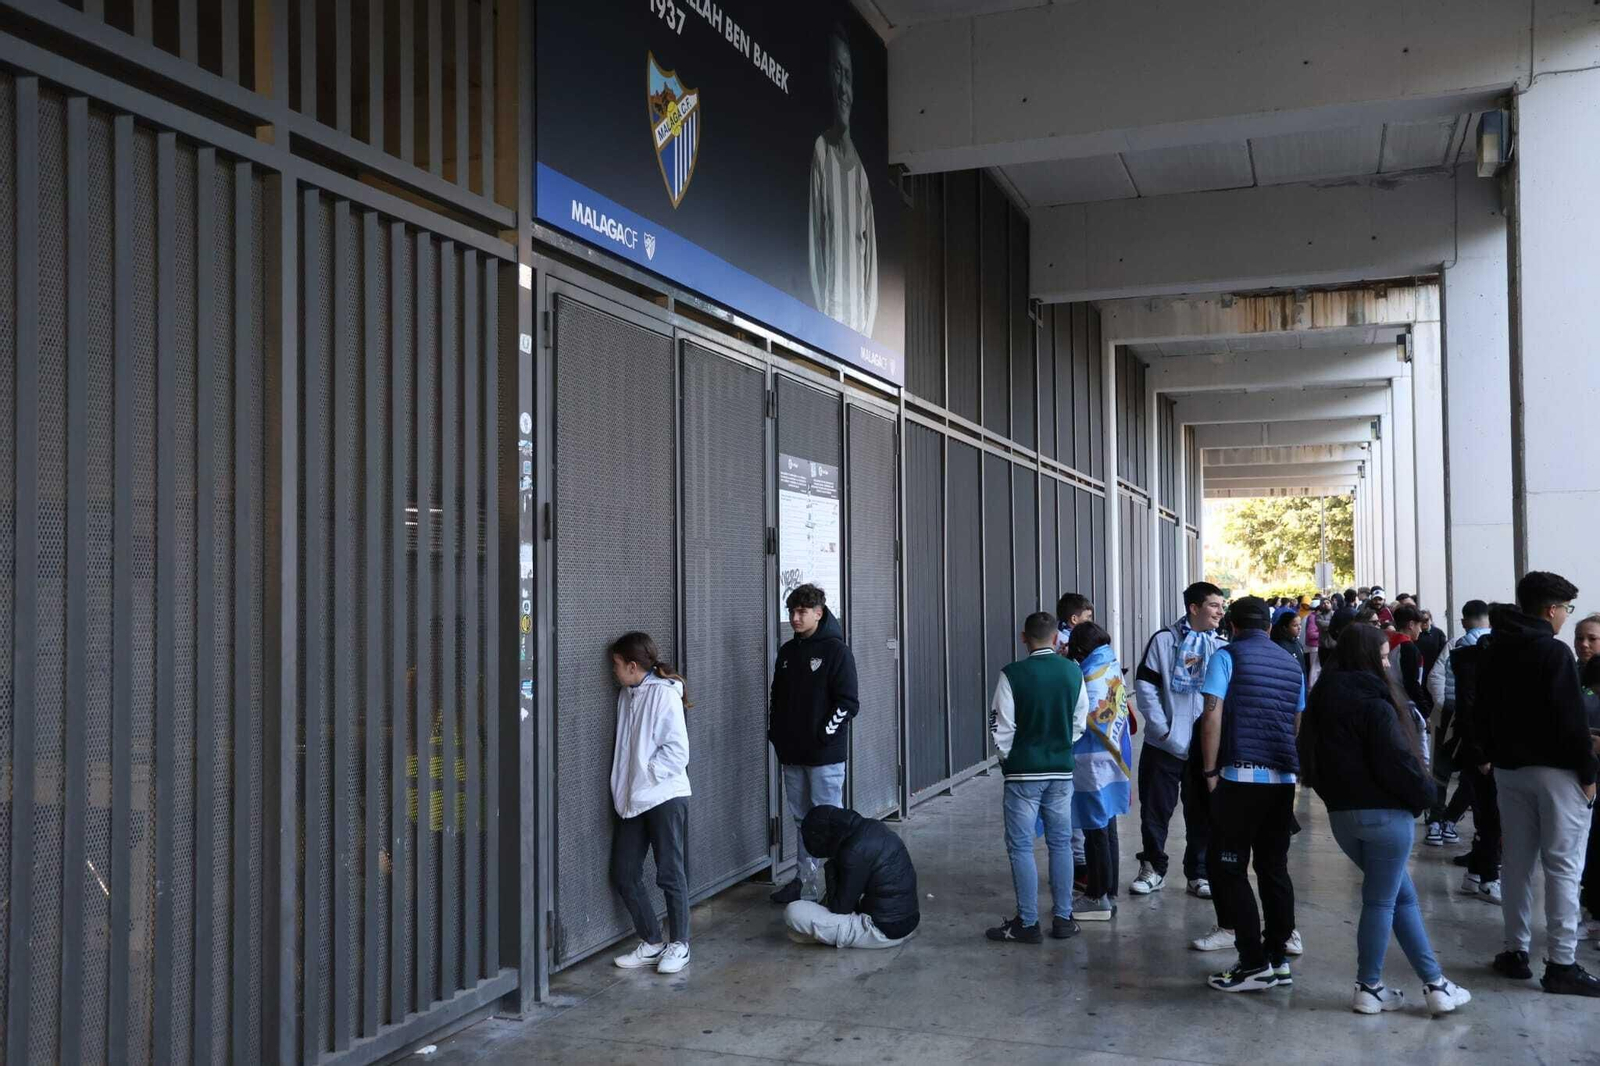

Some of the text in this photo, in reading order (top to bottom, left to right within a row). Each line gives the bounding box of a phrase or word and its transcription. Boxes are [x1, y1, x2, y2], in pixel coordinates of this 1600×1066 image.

[725, 16, 751, 58] BEN
[753, 42, 790, 94] BAREK
[657, 109, 682, 141] MALAGA
